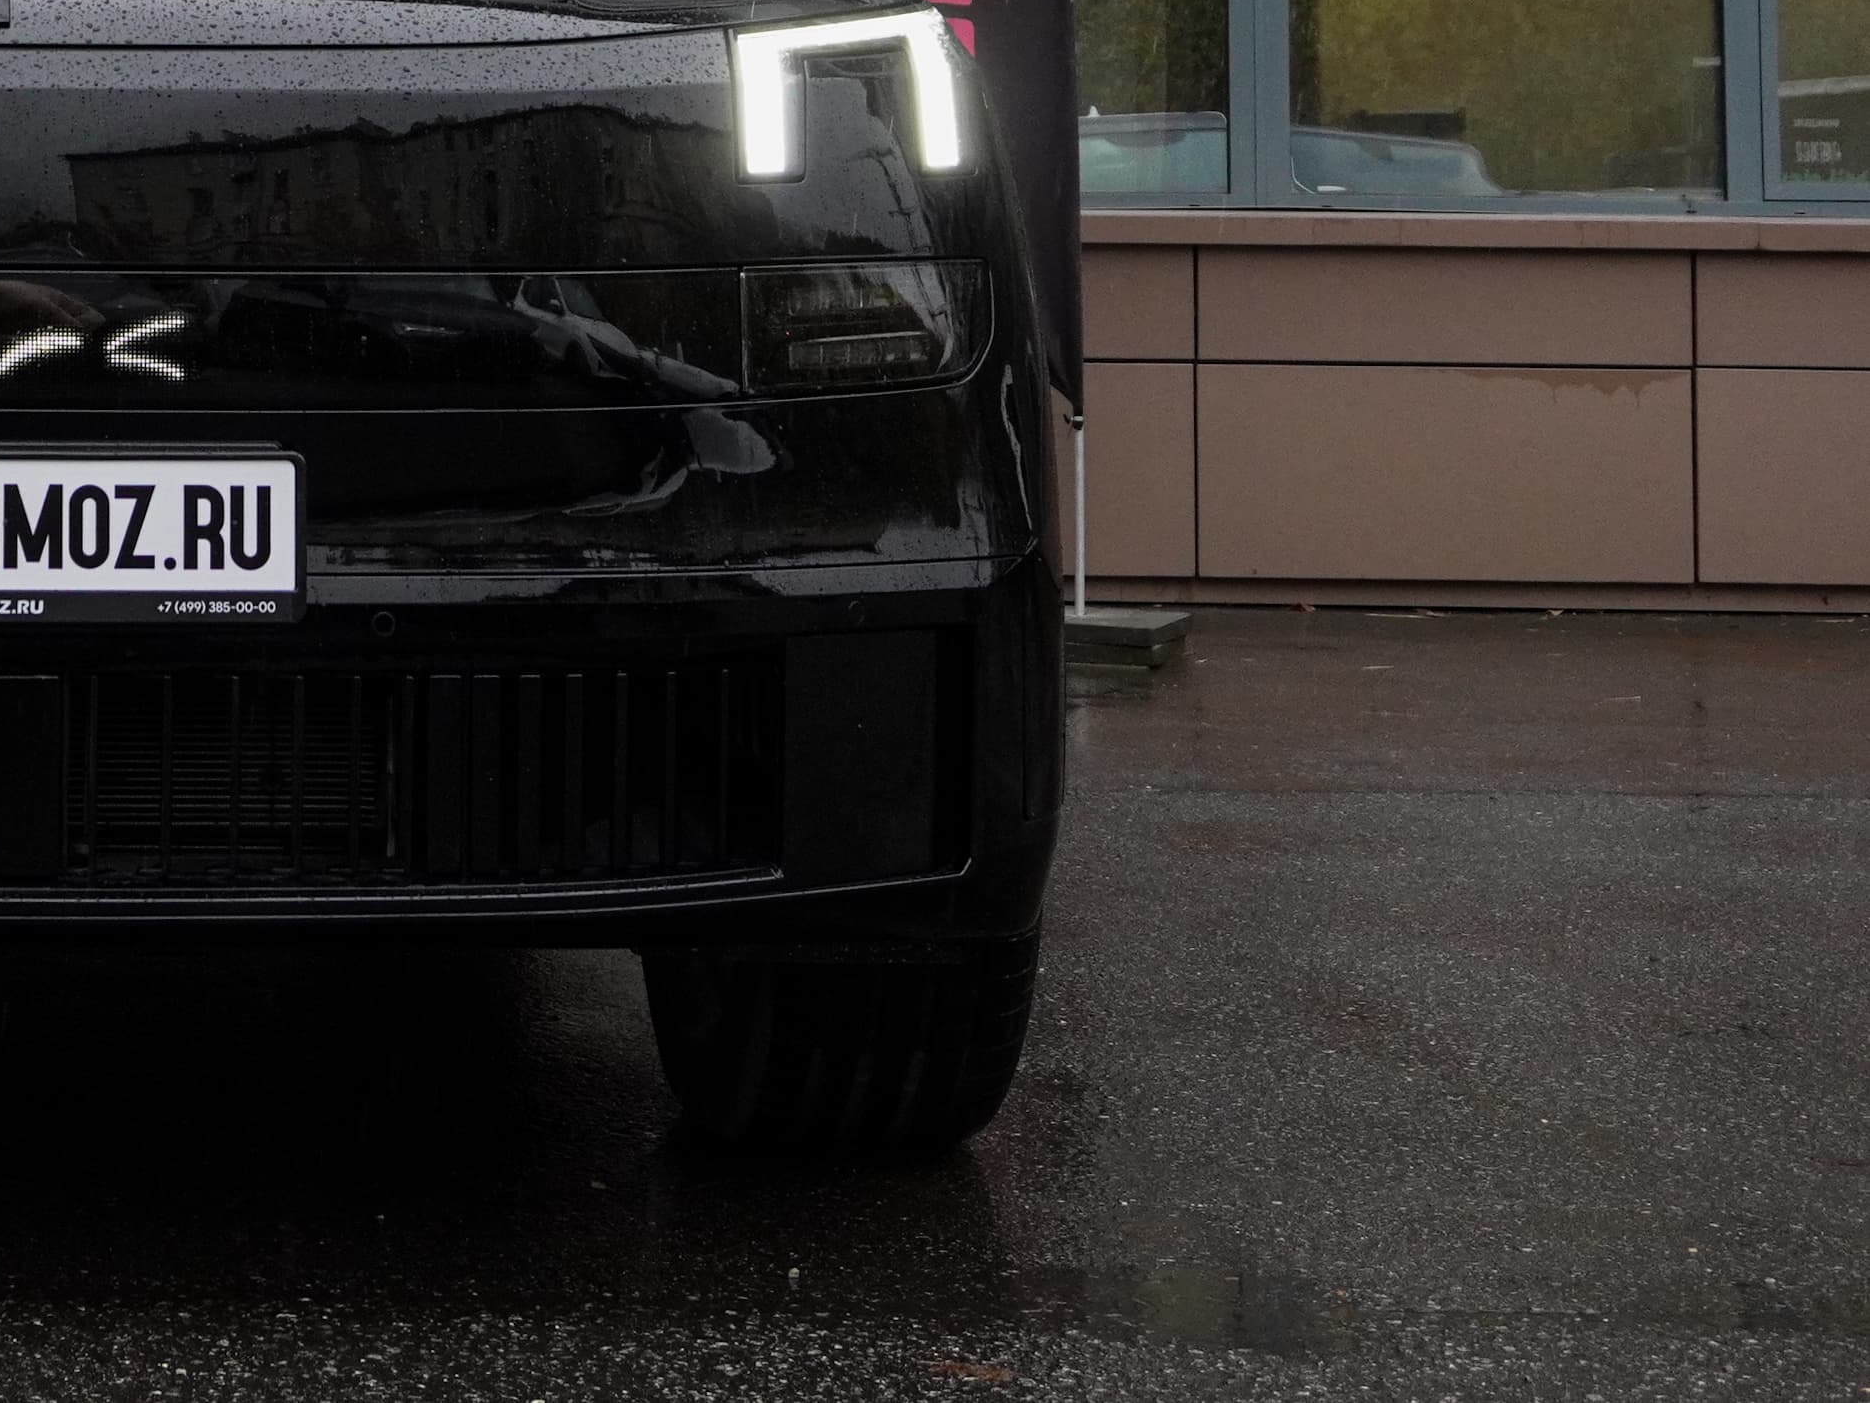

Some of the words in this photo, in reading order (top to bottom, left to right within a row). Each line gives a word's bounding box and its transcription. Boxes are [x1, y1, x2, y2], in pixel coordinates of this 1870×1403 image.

[157, 601, 172, 613] +7
[174, 601, 206, 614] (499)
[208, 601, 276, 613] 385-00-00
